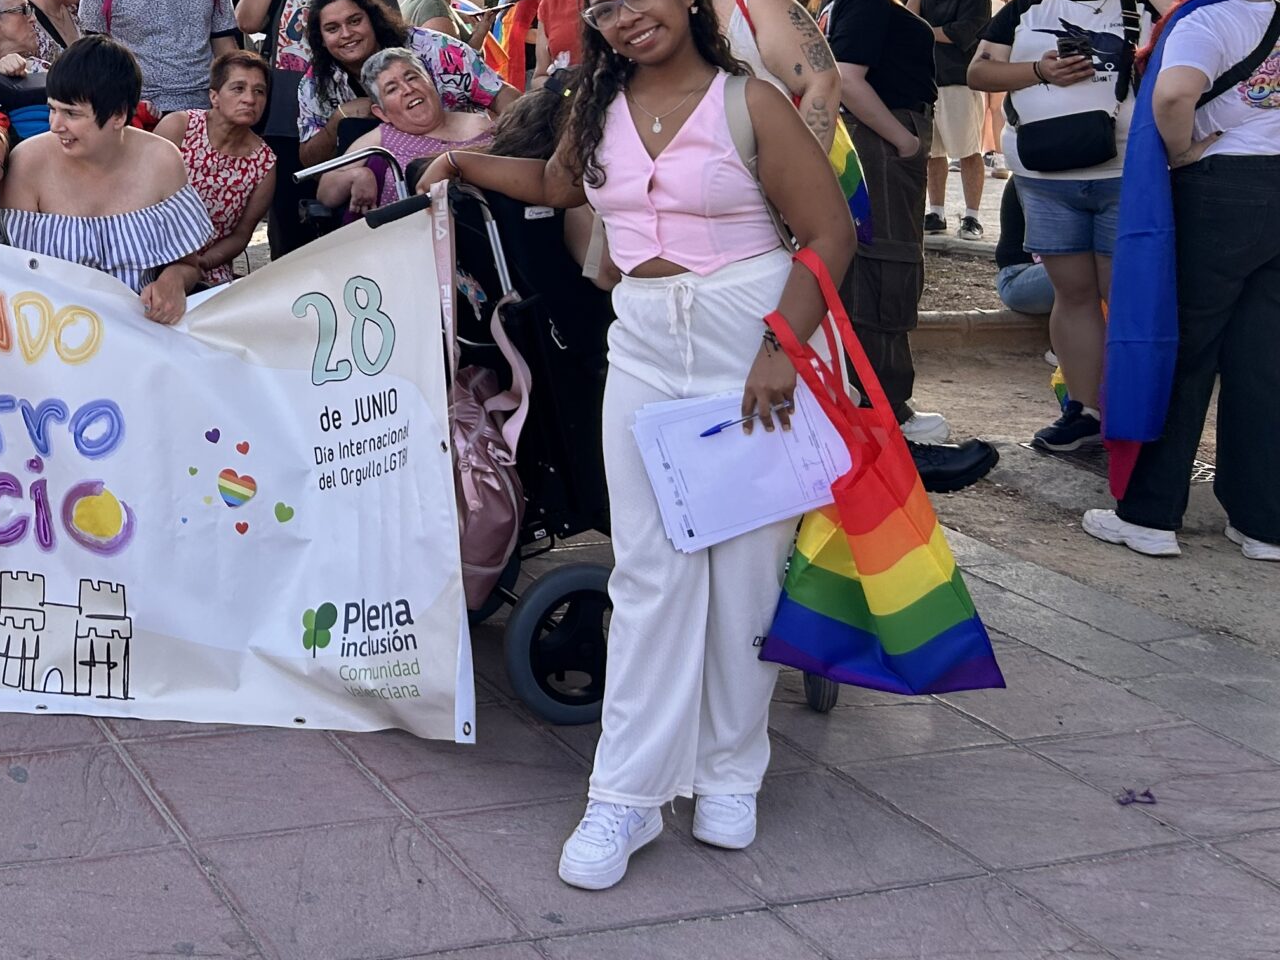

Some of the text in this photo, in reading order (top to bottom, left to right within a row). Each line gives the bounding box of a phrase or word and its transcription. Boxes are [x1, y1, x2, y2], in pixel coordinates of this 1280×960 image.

[434, 194, 448, 240] FILA
[440, 284, 453, 326] FILA
[291, 275, 396, 386] 28
[320, 387, 398, 432] de JUNIO
[314, 419, 409, 465] Día Internacional
[319, 470, 336, 490] del
[340, 460, 382, 486] Orgullo
[343, 597, 414, 635] Plena
[340, 628, 417, 657] inclusión
[339, 657, 420, 682] Comunidad
[344, 683, 421, 700] Valenciana
